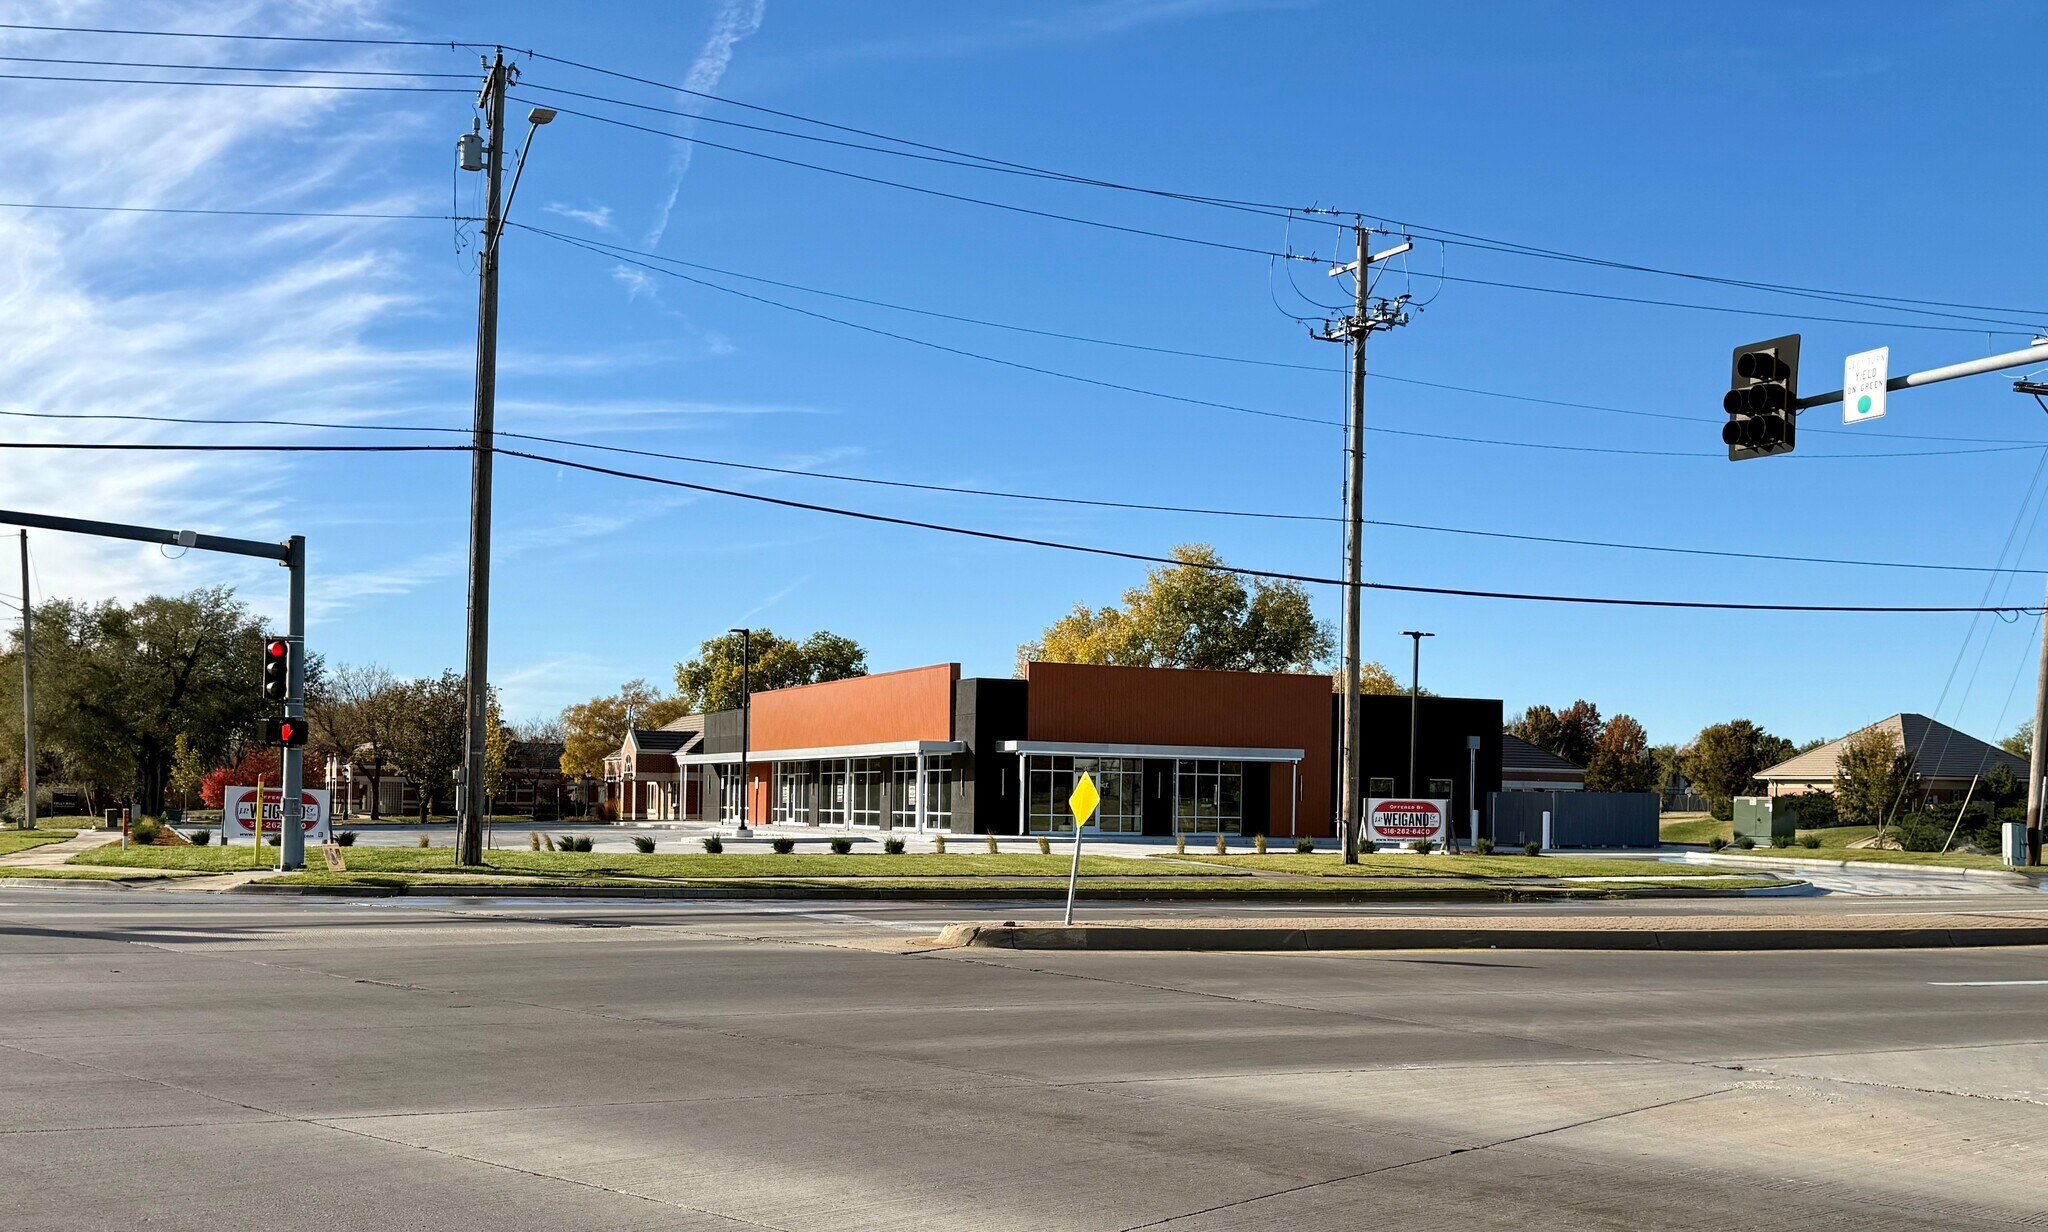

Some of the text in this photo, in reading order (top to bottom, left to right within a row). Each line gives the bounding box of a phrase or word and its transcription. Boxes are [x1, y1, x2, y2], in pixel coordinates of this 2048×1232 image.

[1856, 367, 1877, 381] YIELD
[1847, 380, 1884, 395] ON GREEN
[1383, 812, 1429, 827] WEIGAND
